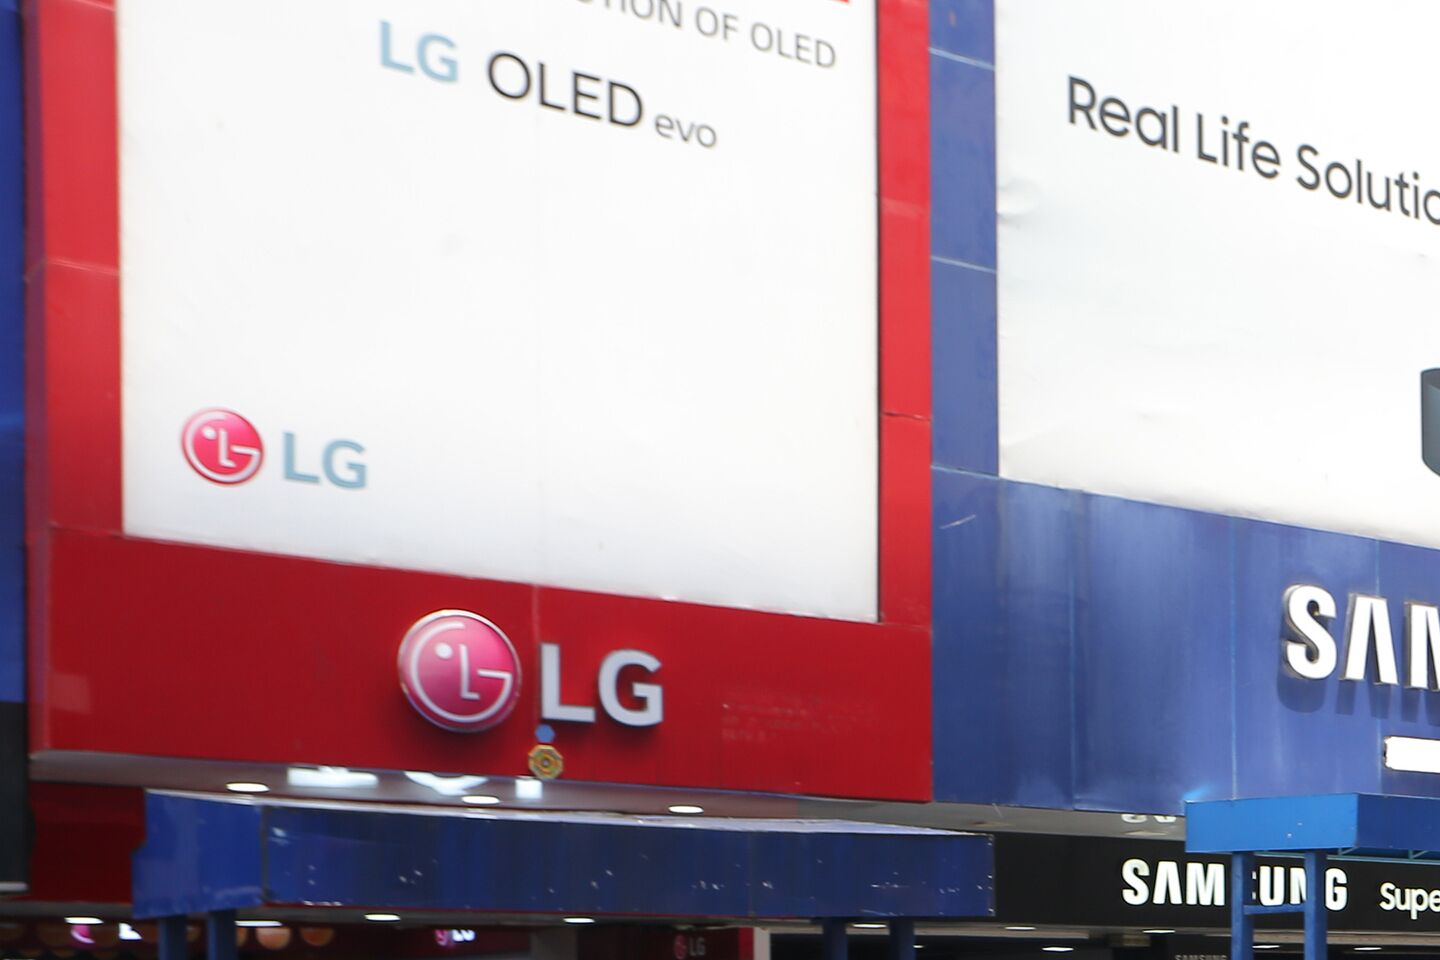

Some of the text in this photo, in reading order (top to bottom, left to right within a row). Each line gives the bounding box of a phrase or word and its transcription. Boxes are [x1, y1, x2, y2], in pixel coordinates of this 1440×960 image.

[695, 6, 739, 40] OF
[750, 22, 837, 69] OLED
[380, 20, 718, 149] LG OLED evo
[1067, 74, 1180, 154] Real
[1196, 111, 1281, 180] Life
[283, 430, 368, 489] LG
[540, 641, 664, 727] LG
[1121, 858, 1349, 912] SAMUNG
[689, 937, 707, 957] LG
